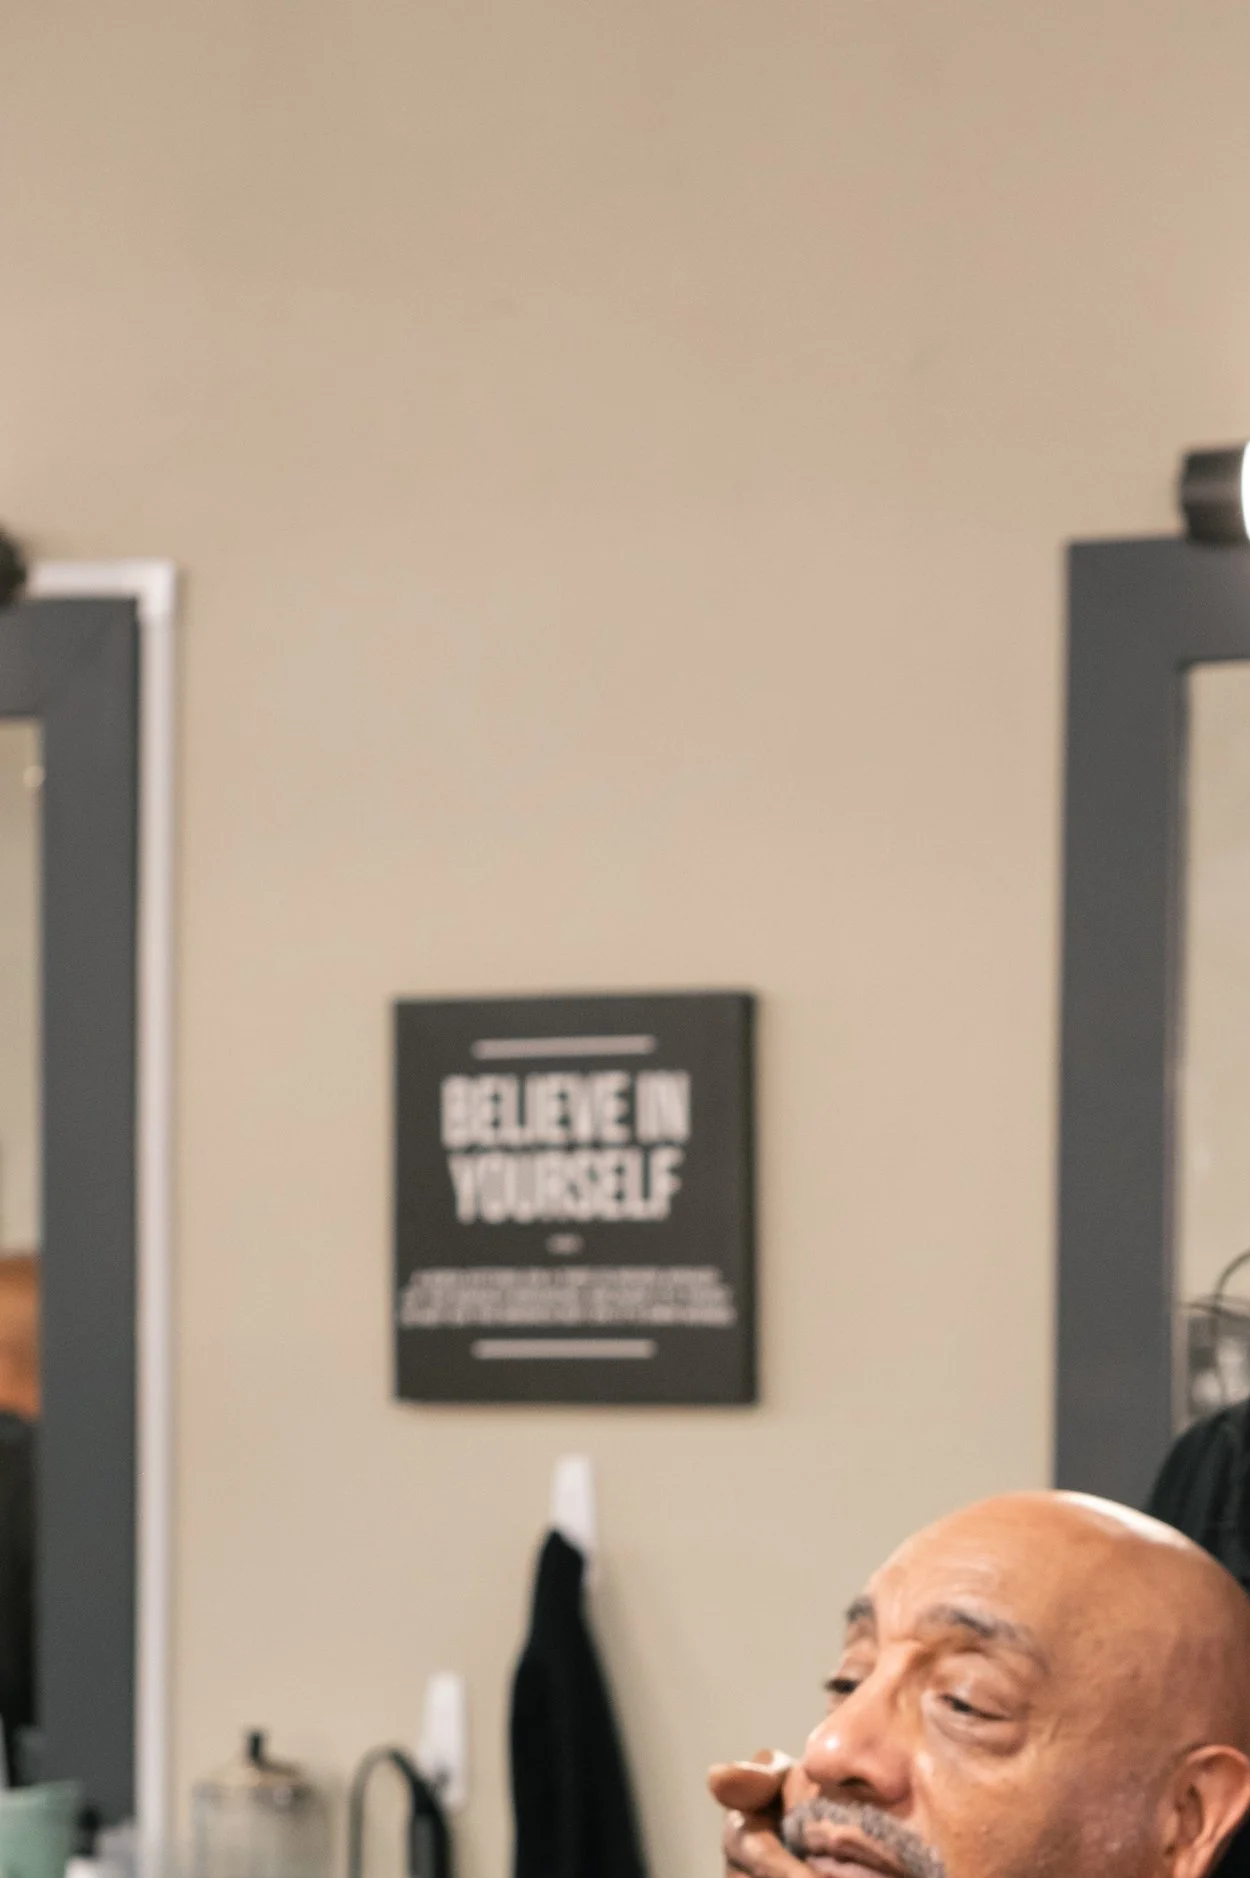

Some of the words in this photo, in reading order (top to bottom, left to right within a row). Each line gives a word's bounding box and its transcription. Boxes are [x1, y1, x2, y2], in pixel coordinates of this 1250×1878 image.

[441, 1072, 631, 1149] BELIEVE
[635, 1069, 690, 1144] IN
[449, 1146, 685, 1224] YOURSELF
